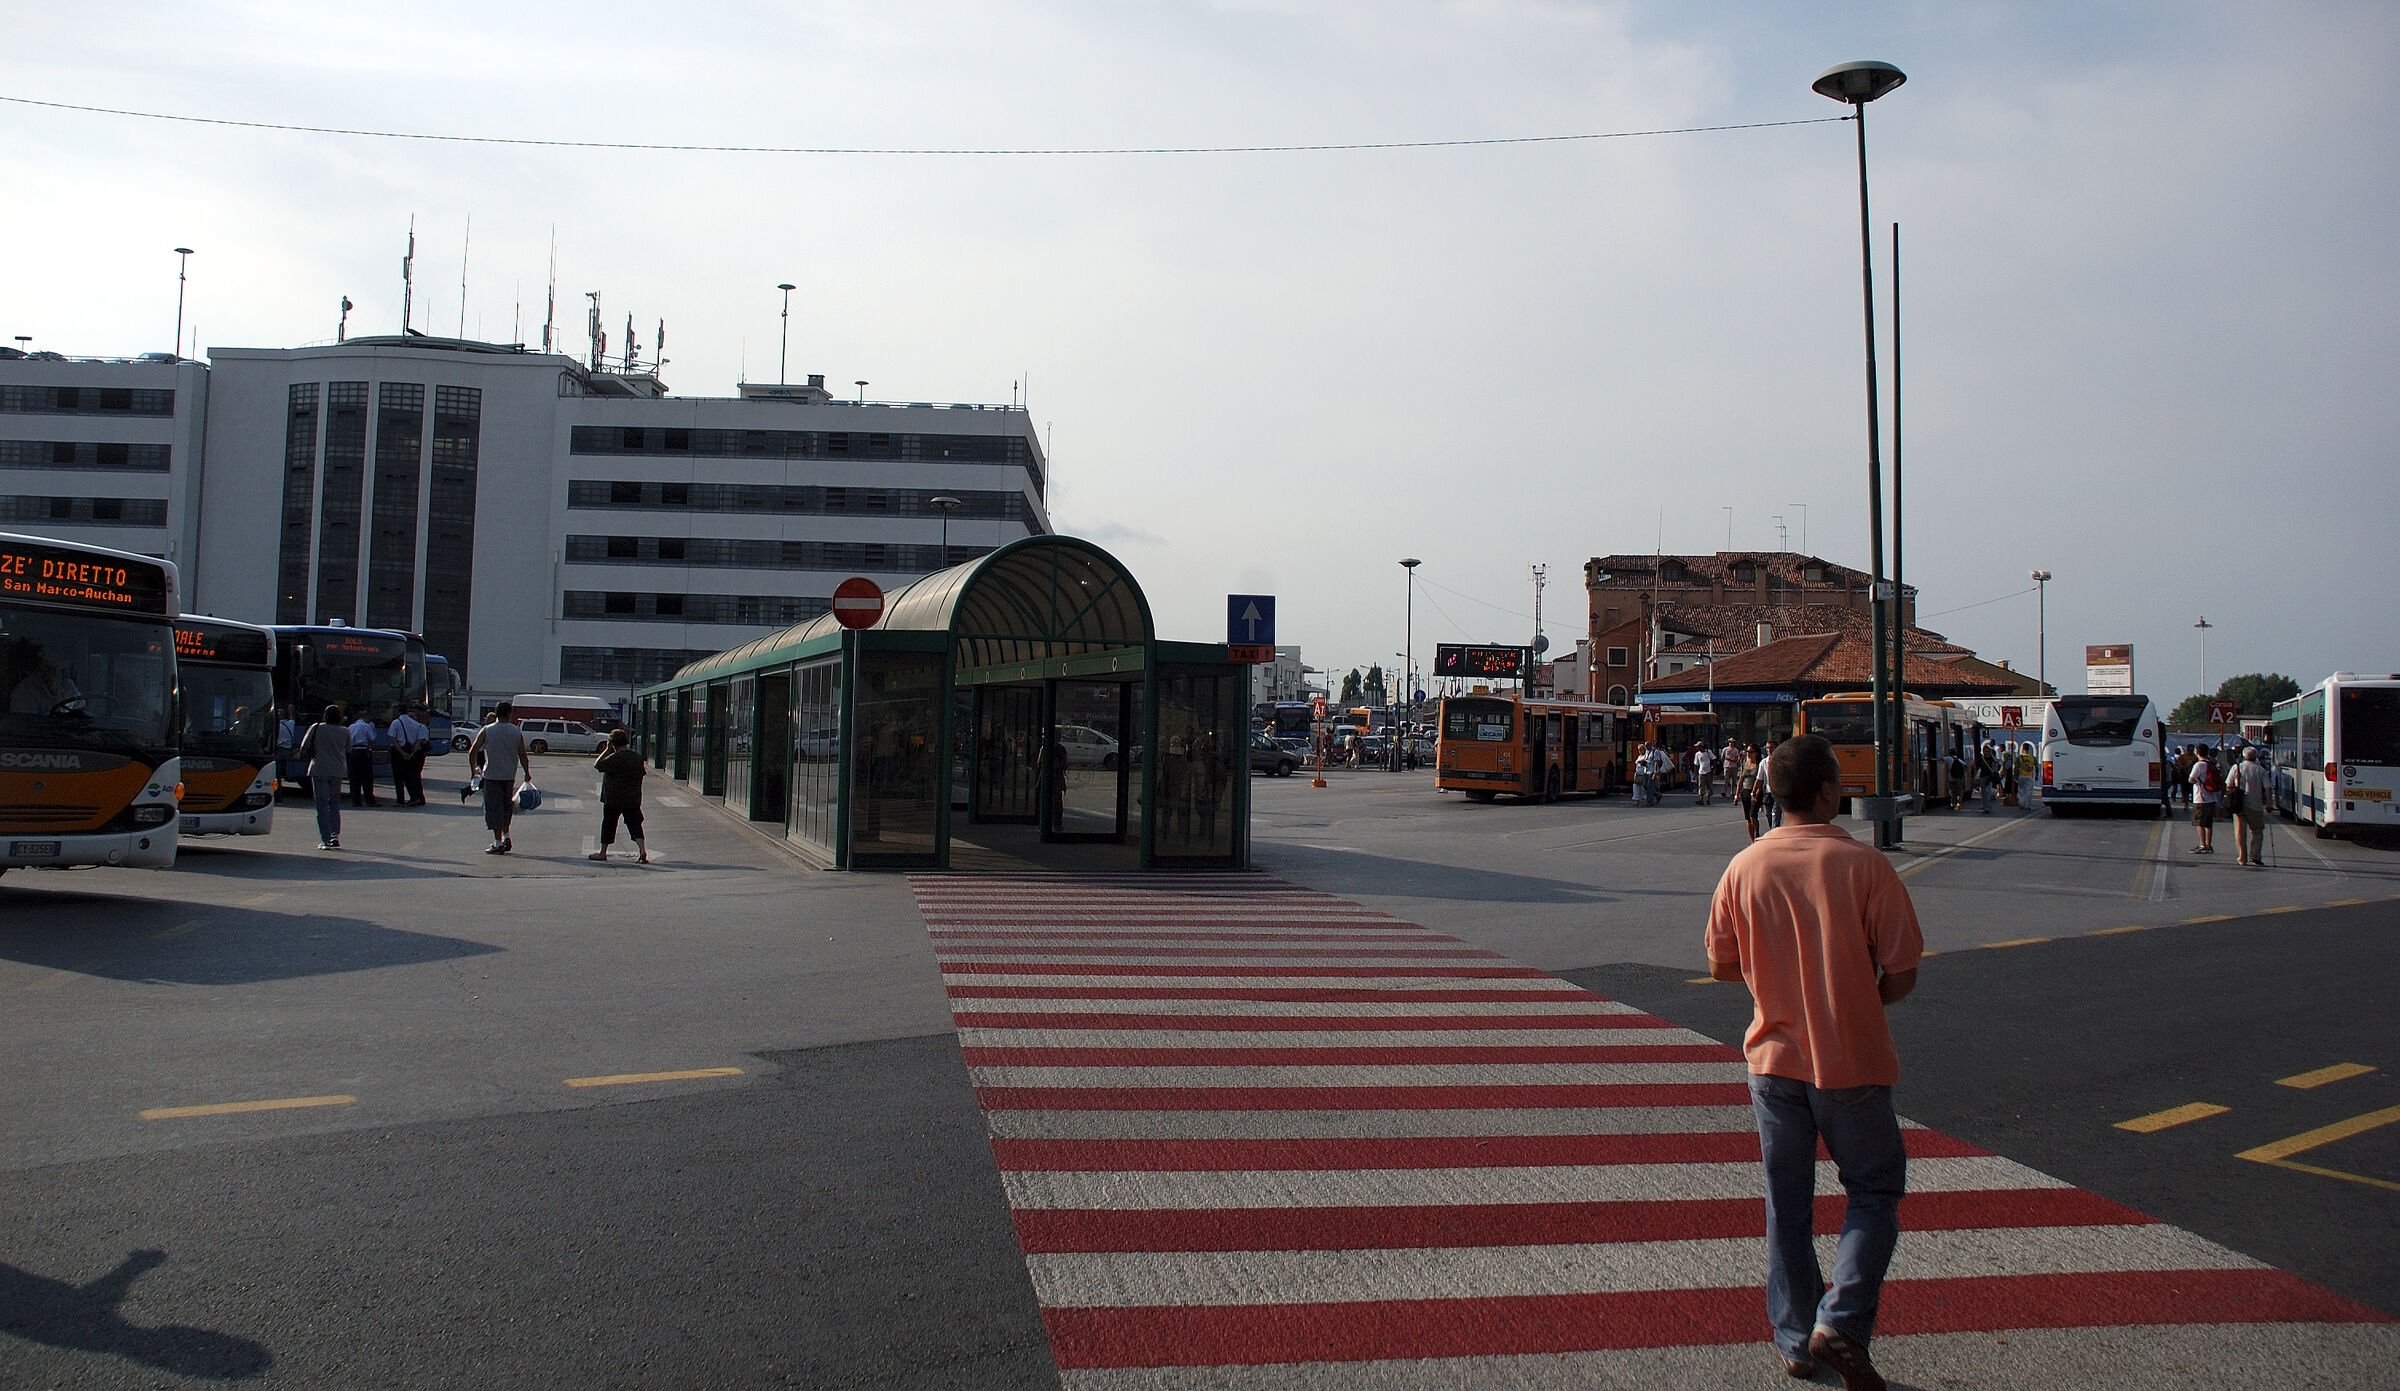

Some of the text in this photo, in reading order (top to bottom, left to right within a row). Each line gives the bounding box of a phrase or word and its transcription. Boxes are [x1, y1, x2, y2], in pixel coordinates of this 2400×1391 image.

[42, 559, 127, 587] DIRETTO
[3, 577, 132, 603] San Marco-Auchan
[175, 645, 216, 657] Maerne
[1232, 648, 1259, 659] TAXI
[0, 752, 82, 769] SCANIA
[2344, 790, 2392, 800] LONG VEHICLE
